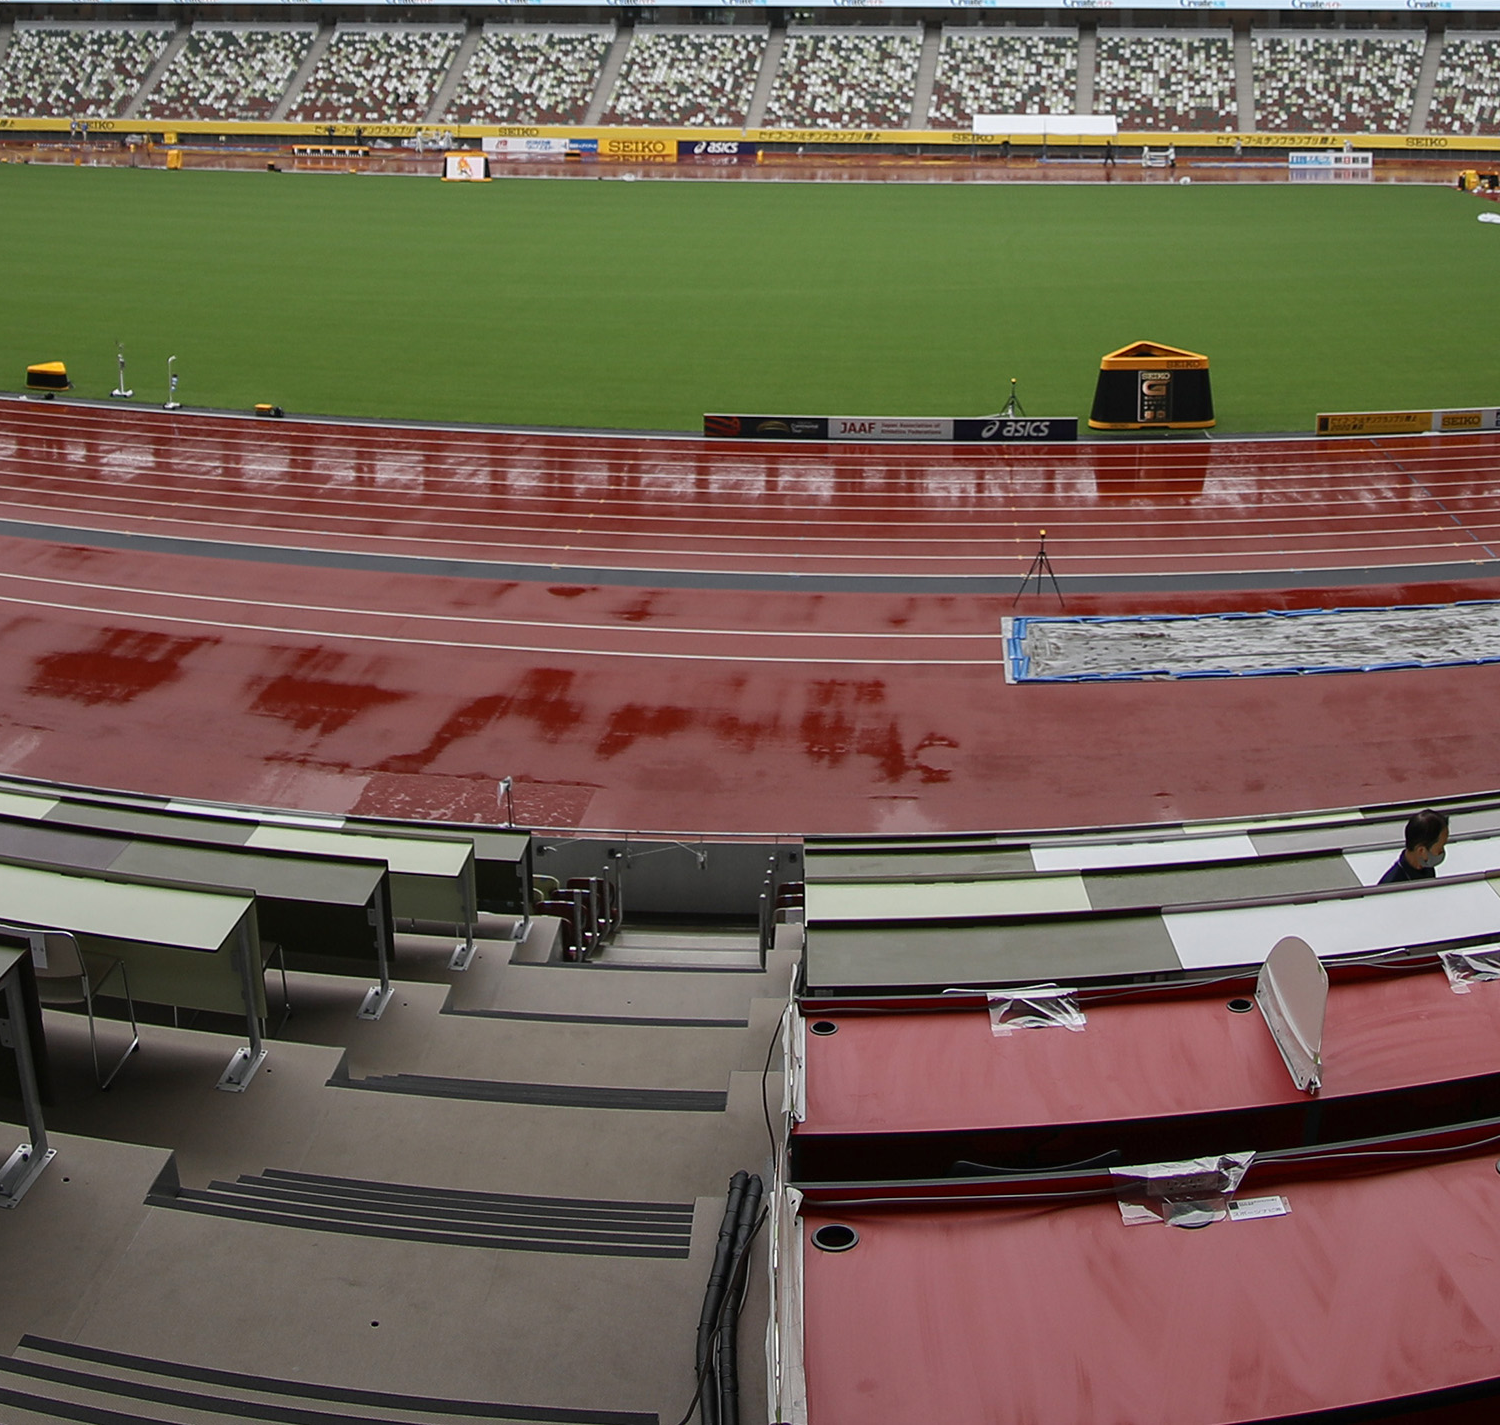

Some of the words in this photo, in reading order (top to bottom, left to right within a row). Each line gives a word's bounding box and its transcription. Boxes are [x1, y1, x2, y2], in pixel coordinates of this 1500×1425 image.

[499, 127, 539, 137] SEIKO
[608, 141, 666, 154] SEIKO
[1406, 137, 1447, 147] SEIKO
[1442, 415, 1481, 426] SEIKO
[840, 422, 875, 434] JAAF
[1002, 422, 1050, 436] asics
